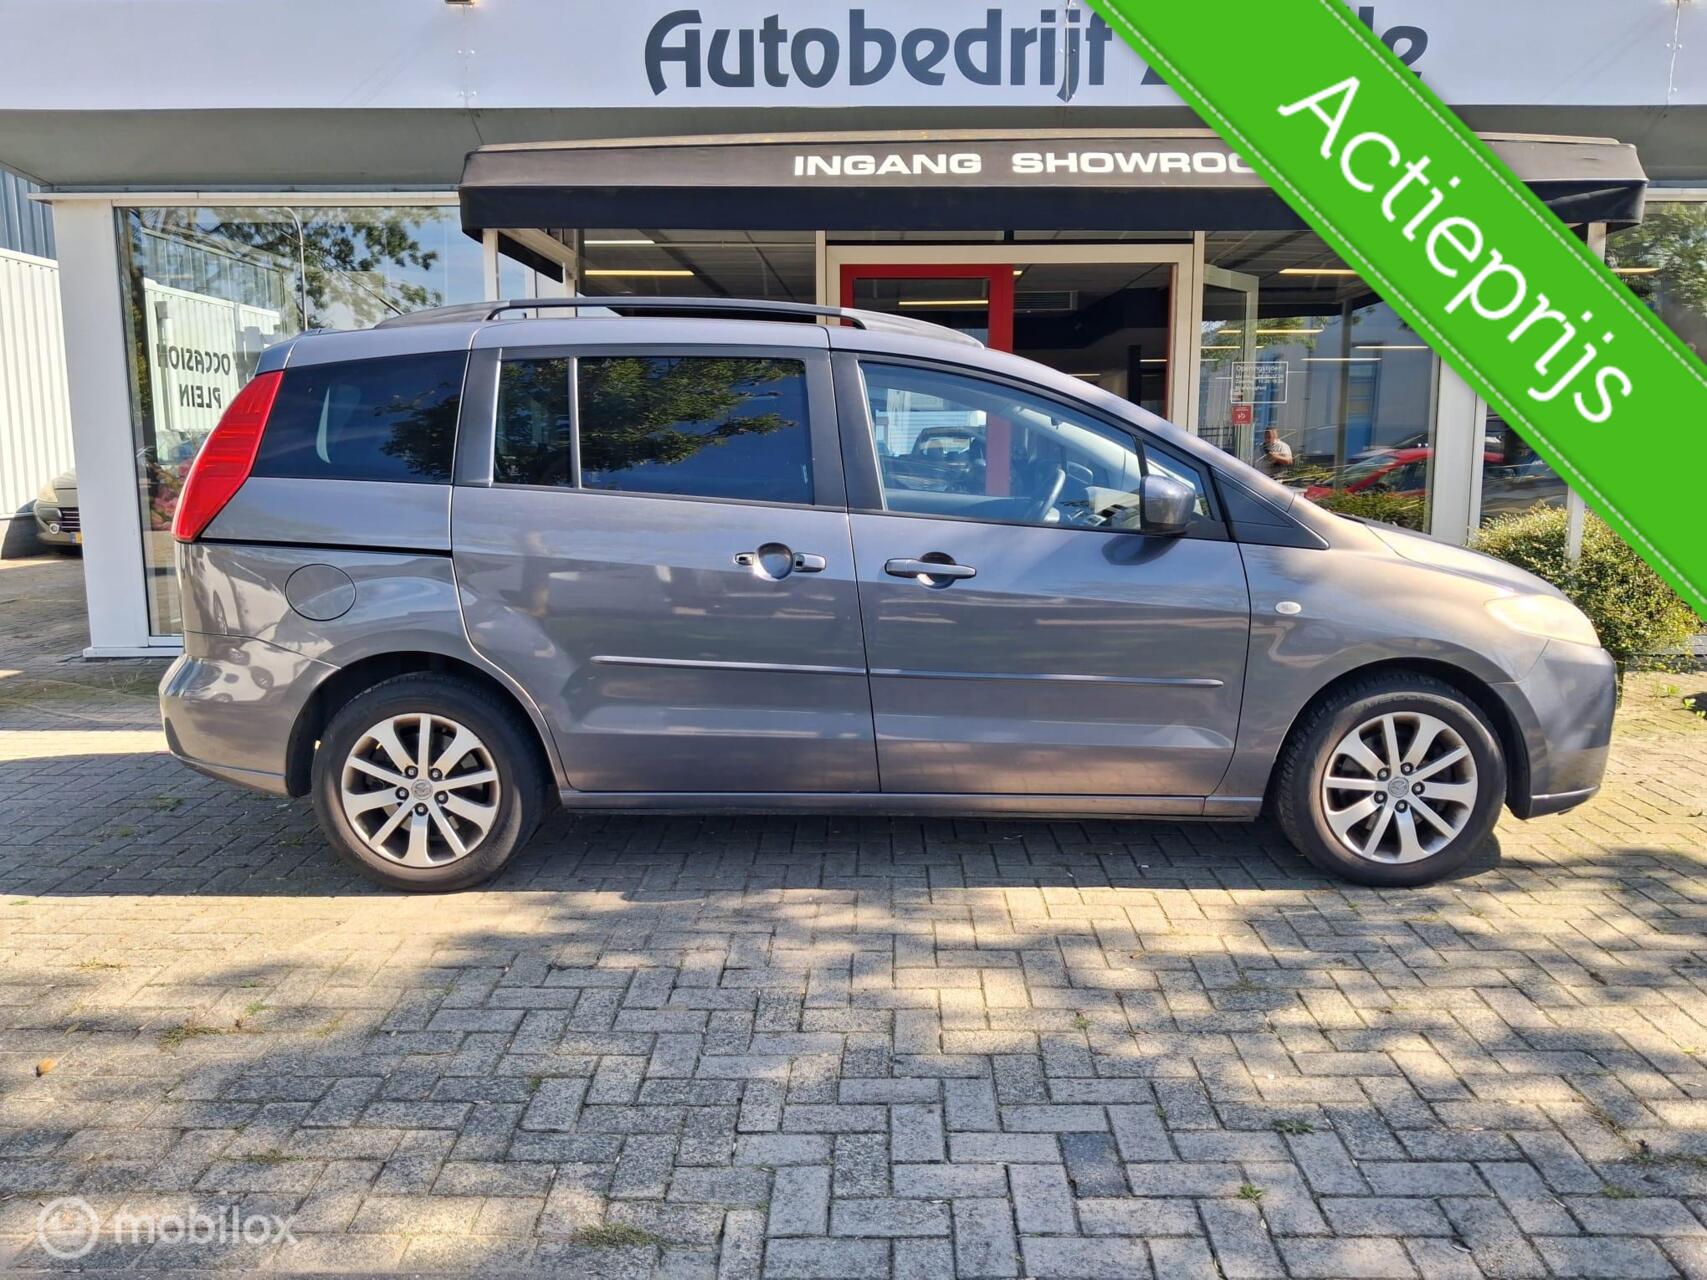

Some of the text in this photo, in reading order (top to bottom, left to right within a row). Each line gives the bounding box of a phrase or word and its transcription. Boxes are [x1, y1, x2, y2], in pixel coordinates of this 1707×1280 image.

[644, 8, 1113, 103] Autobedrijf
[793, 151, 1257, 176] INGANG SHOWROO
